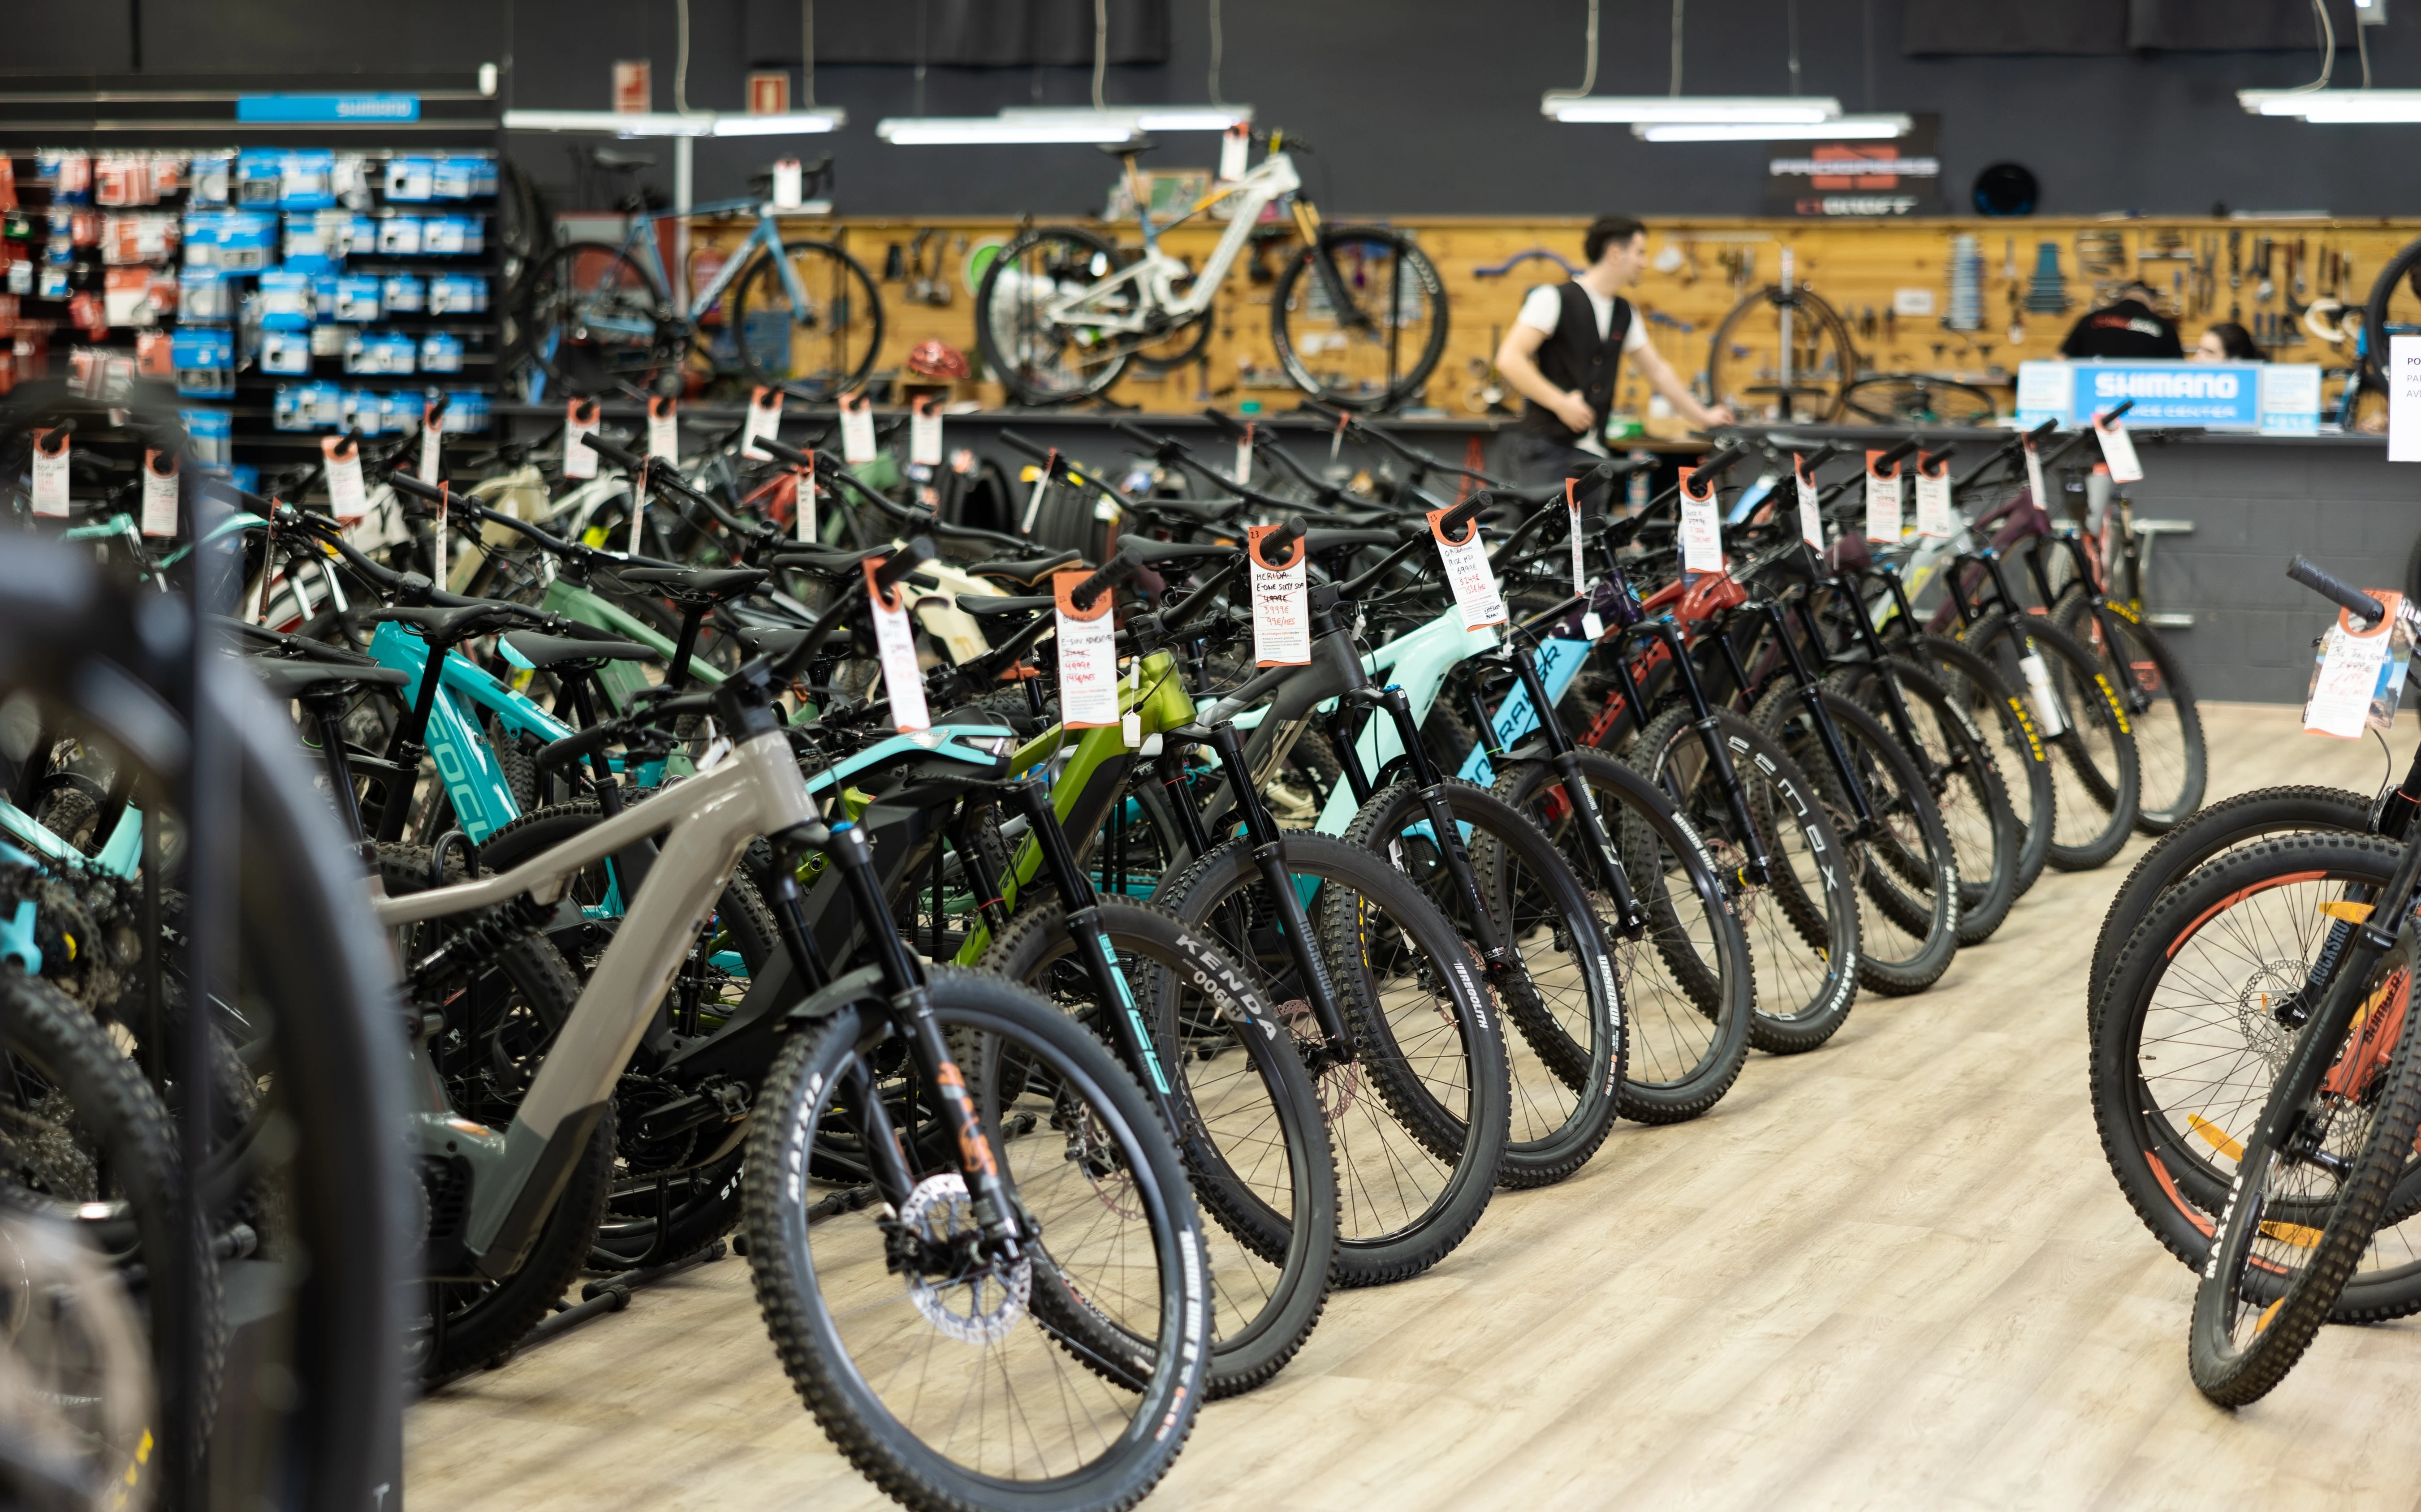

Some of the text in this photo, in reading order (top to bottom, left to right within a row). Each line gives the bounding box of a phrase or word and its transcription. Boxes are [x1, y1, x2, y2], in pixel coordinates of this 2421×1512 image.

[2095, 373, 2238, 399] SHIMANO
[1250, 530, 1260, 539] 23
[1256, 571, 1287, 581] MERIDA
[1278, 582, 1293, 591] SIXTY
[1263, 605, 1289, 614] 3999€
[1267, 616, 1295, 627] 99€/MES
[1581, 783, 1598, 811] DIAMOND
[1671, 810, 1704, 850] MINION
[1175, 934, 1277, 1041] KENDA
[1597, 955, 1621, 1027] DISSECTOR
[1459, 973, 1490, 1030] REGOLITH
[2205, 1175, 2244, 1280] MAXXIS
